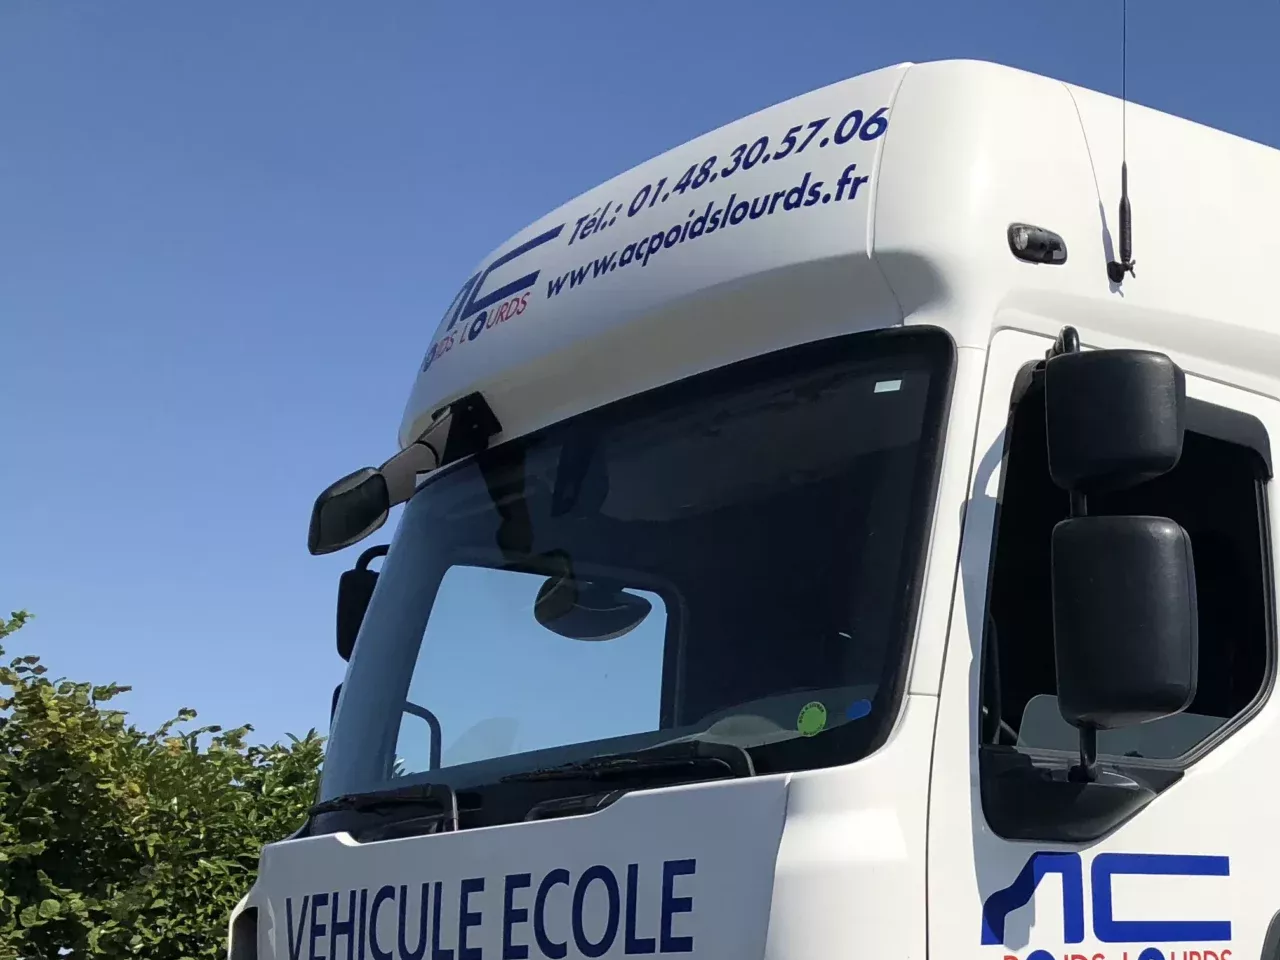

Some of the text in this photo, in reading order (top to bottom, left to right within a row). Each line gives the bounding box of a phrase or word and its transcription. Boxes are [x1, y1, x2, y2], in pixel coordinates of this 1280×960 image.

[627, 107, 890, 218] 01.48.30.57.06
[546, 163, 870, 299] www.acpoidslourds.fr
[459, 291, 530, 344] LOURDS
[502, 859, 697, 960] ECOLE
[981, 850, 1232, 945] AC
